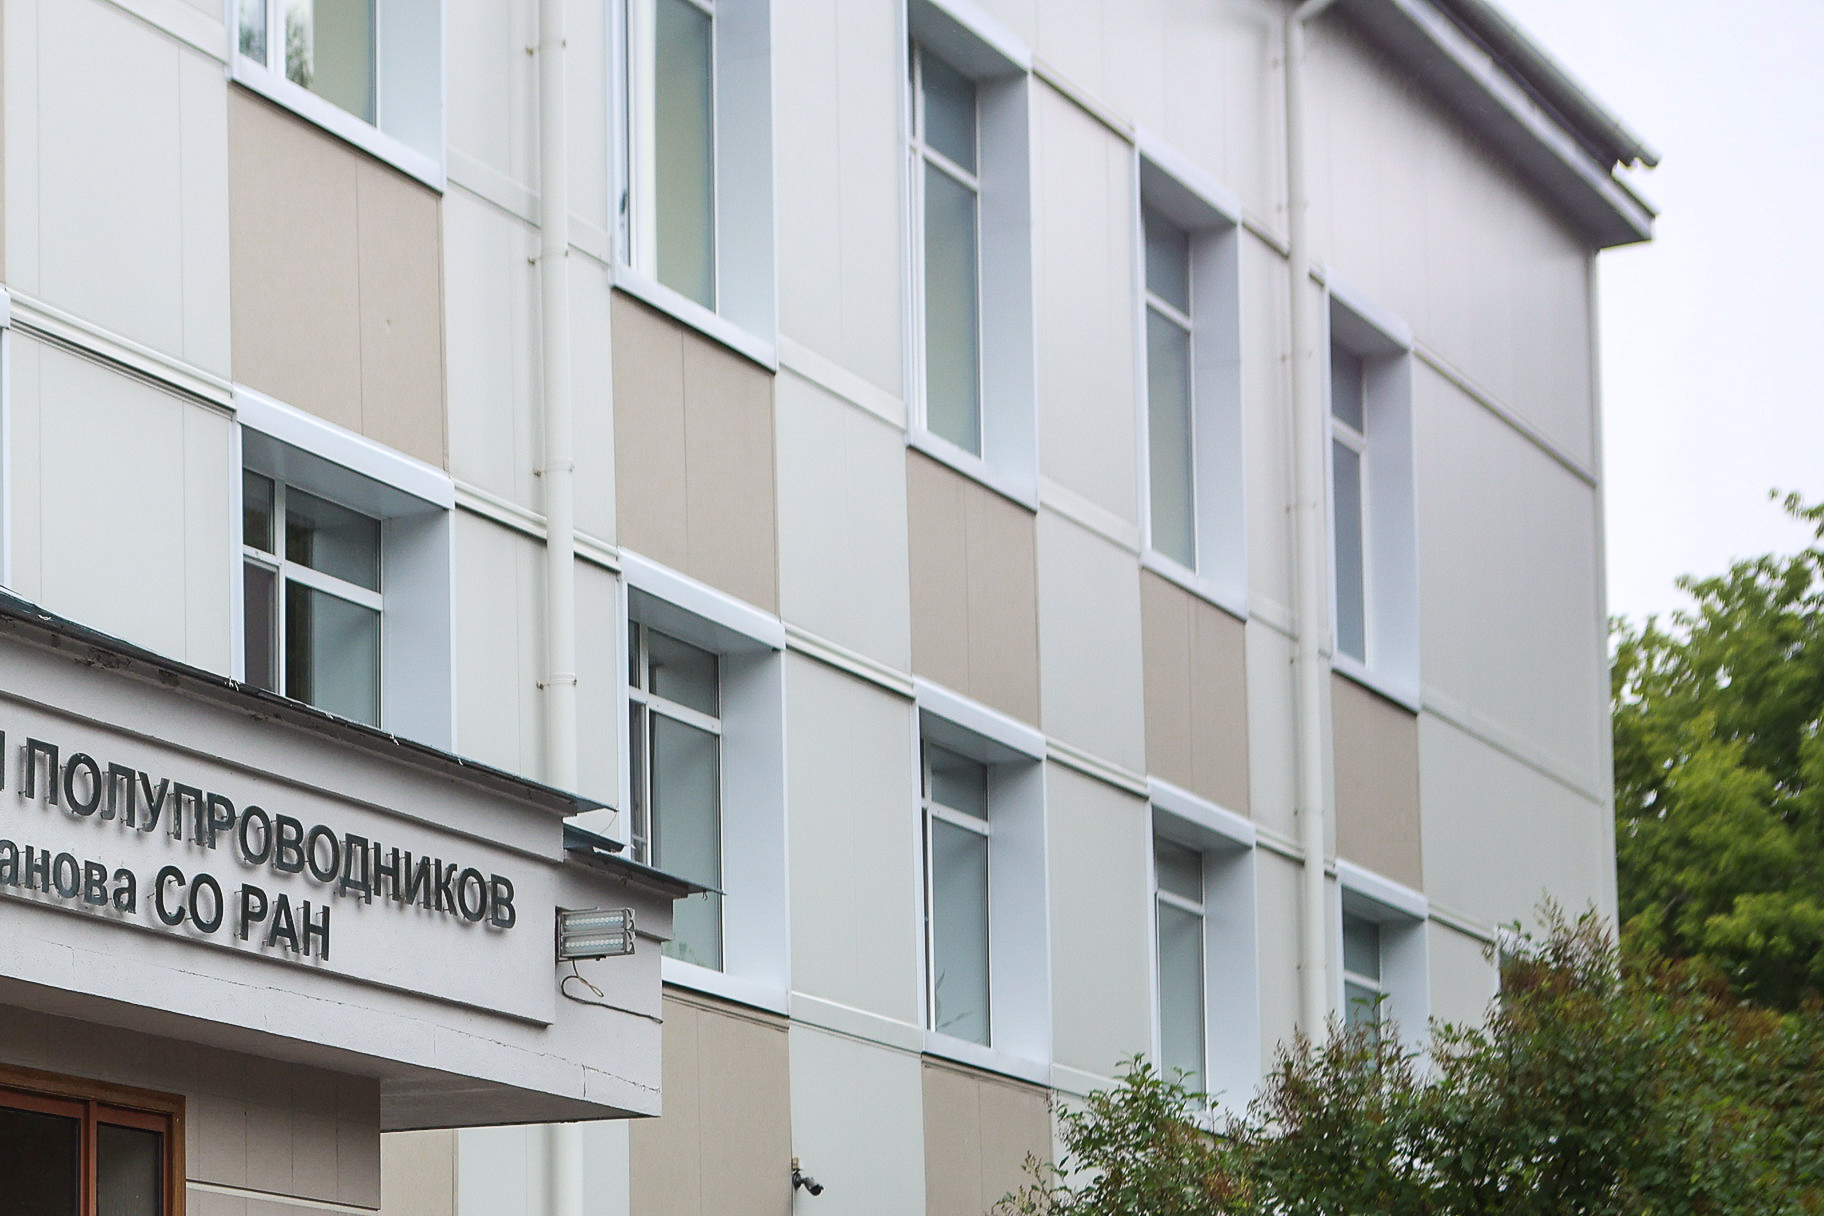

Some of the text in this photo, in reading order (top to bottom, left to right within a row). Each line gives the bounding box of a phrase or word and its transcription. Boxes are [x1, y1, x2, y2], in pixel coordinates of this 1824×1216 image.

[26, 737, 517, 929] ПОЛУПРОВОДНИКОВ
[155, 865, 224, 933] СО
[241, 883, 331, 962] РАН
